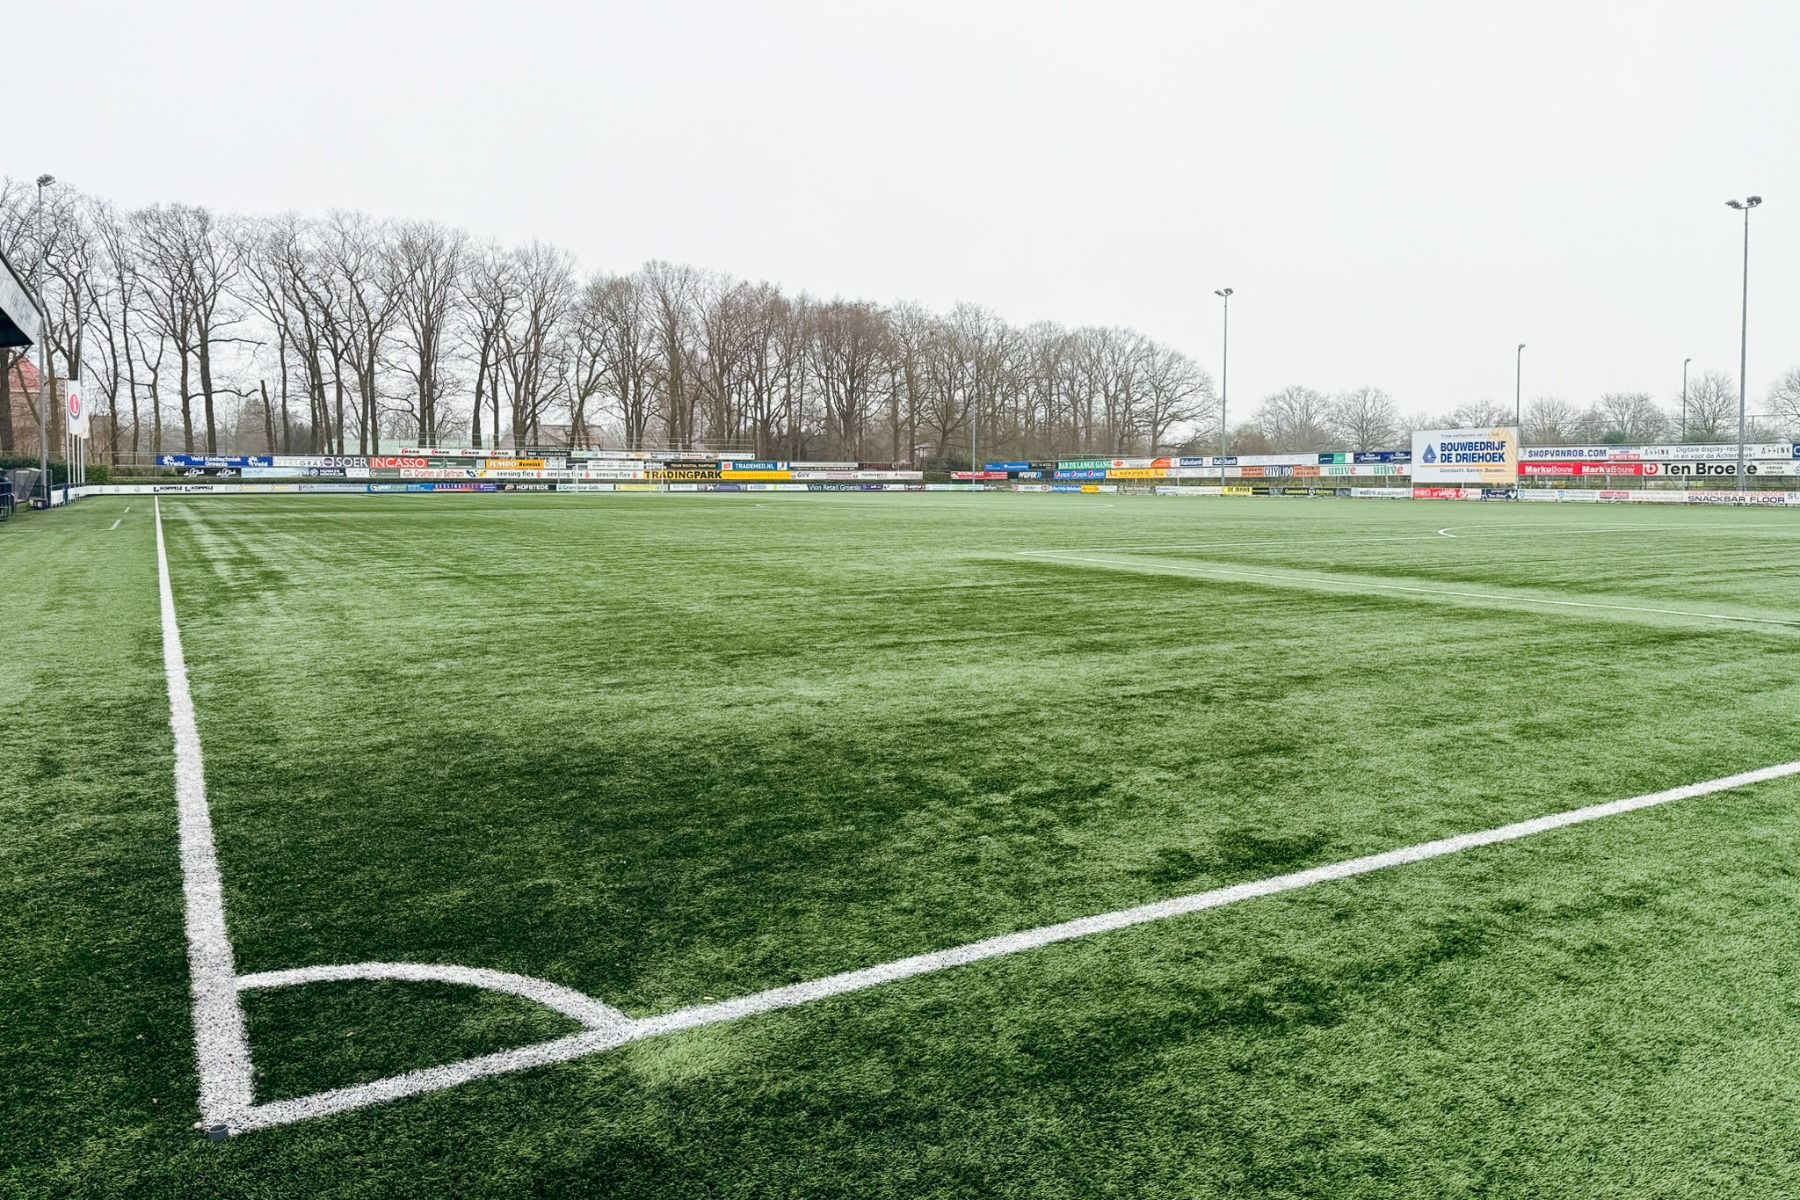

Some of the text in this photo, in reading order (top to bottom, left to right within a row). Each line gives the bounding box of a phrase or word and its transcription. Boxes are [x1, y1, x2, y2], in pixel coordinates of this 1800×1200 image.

[1440, 441, 1506, 452] BOUWBEDRIJF
[1440, 452, 1505, 464] DE DRIEHOEK
[1528, 449, 1607, 458] SHOPVANROB.COM
[336, 457, 426, 468] SOER INCASSO
[1661, 463, 1691, 475] Ten
[644, 470, 722, 480] TRADINGPARK
[1750, 496, 1785, 504] FLOOR
